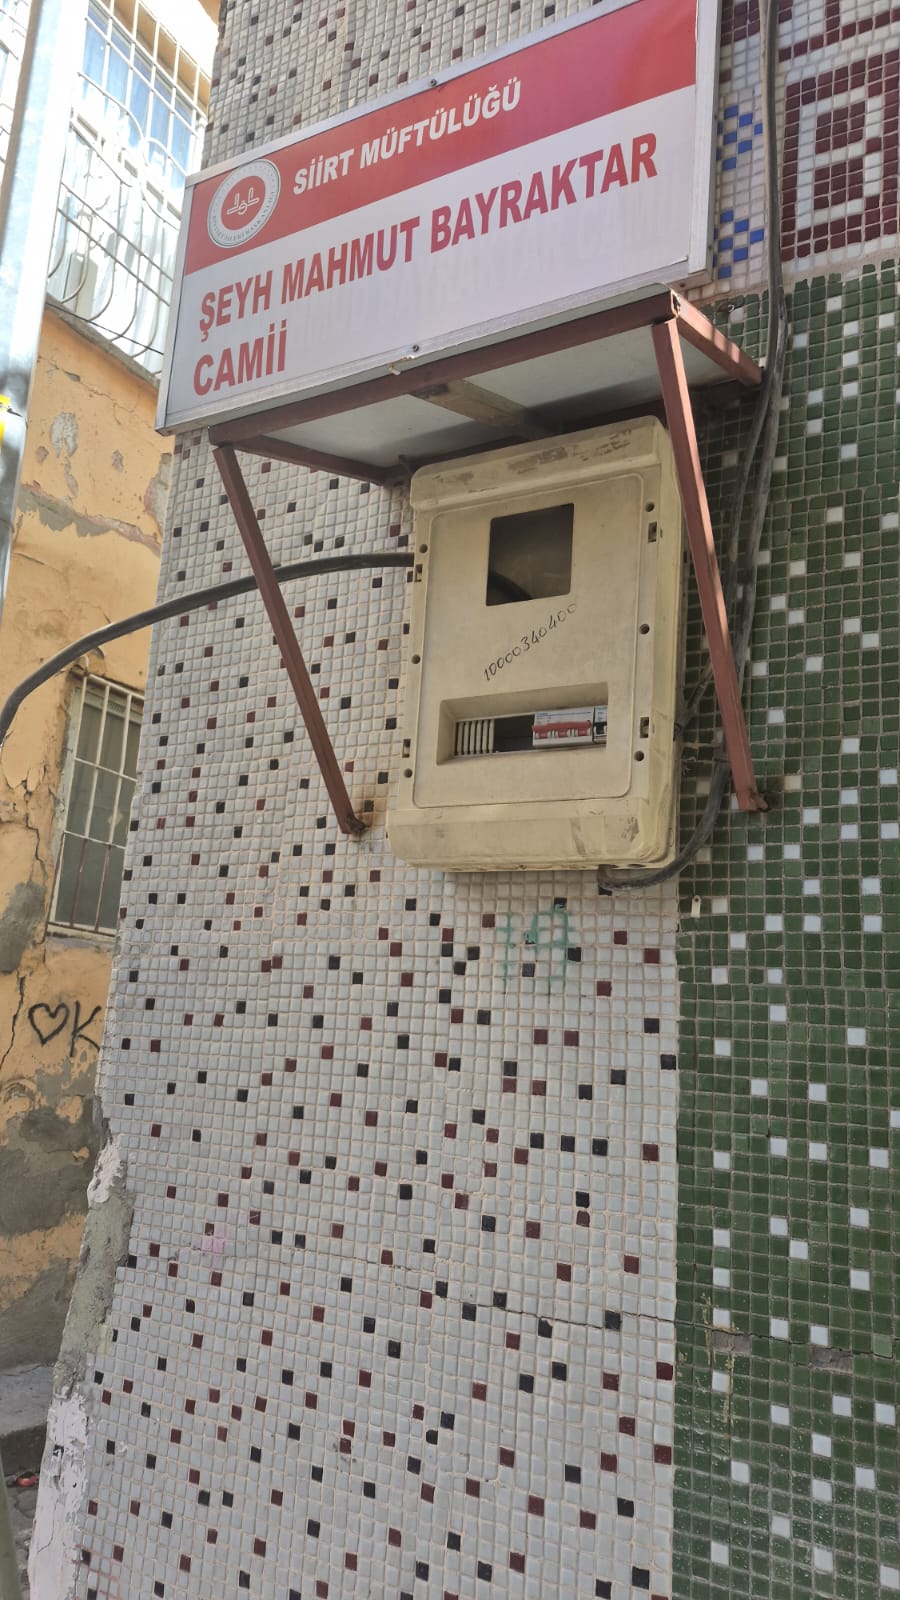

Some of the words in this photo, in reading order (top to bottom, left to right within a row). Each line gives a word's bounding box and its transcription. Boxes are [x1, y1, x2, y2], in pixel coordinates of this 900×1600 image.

[293, 149, 355, 195] SİİRT
[359, 76, 521, 169] MÜFTÜLÜĞÜ
[199, 270, 273, 342] ŞEYH
[281, 216, 420, 305] MAHMUT
[430, 132, 658, 254] BAYRAKTAR
[193, 318, 288, 396] CAMİİ
[483, 603, 577, 682] 10000340400
